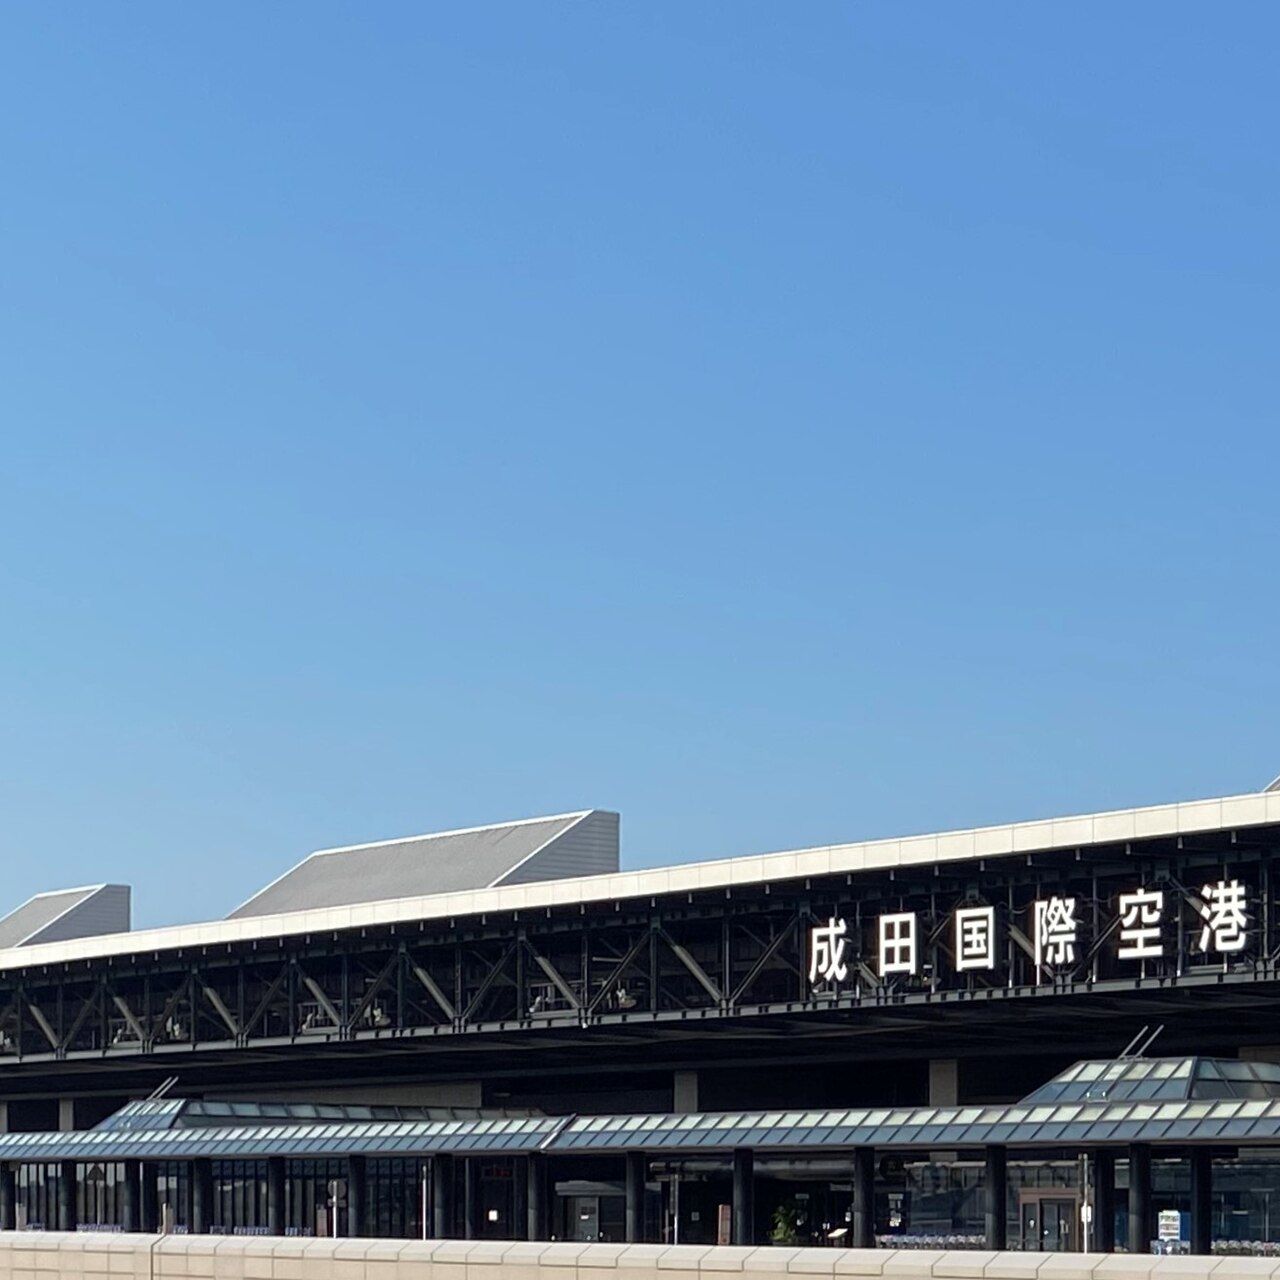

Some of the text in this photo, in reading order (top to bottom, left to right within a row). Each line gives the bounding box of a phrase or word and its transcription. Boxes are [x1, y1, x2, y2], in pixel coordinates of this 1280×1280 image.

[808, 879, 1250, 984] 成田国際空港
